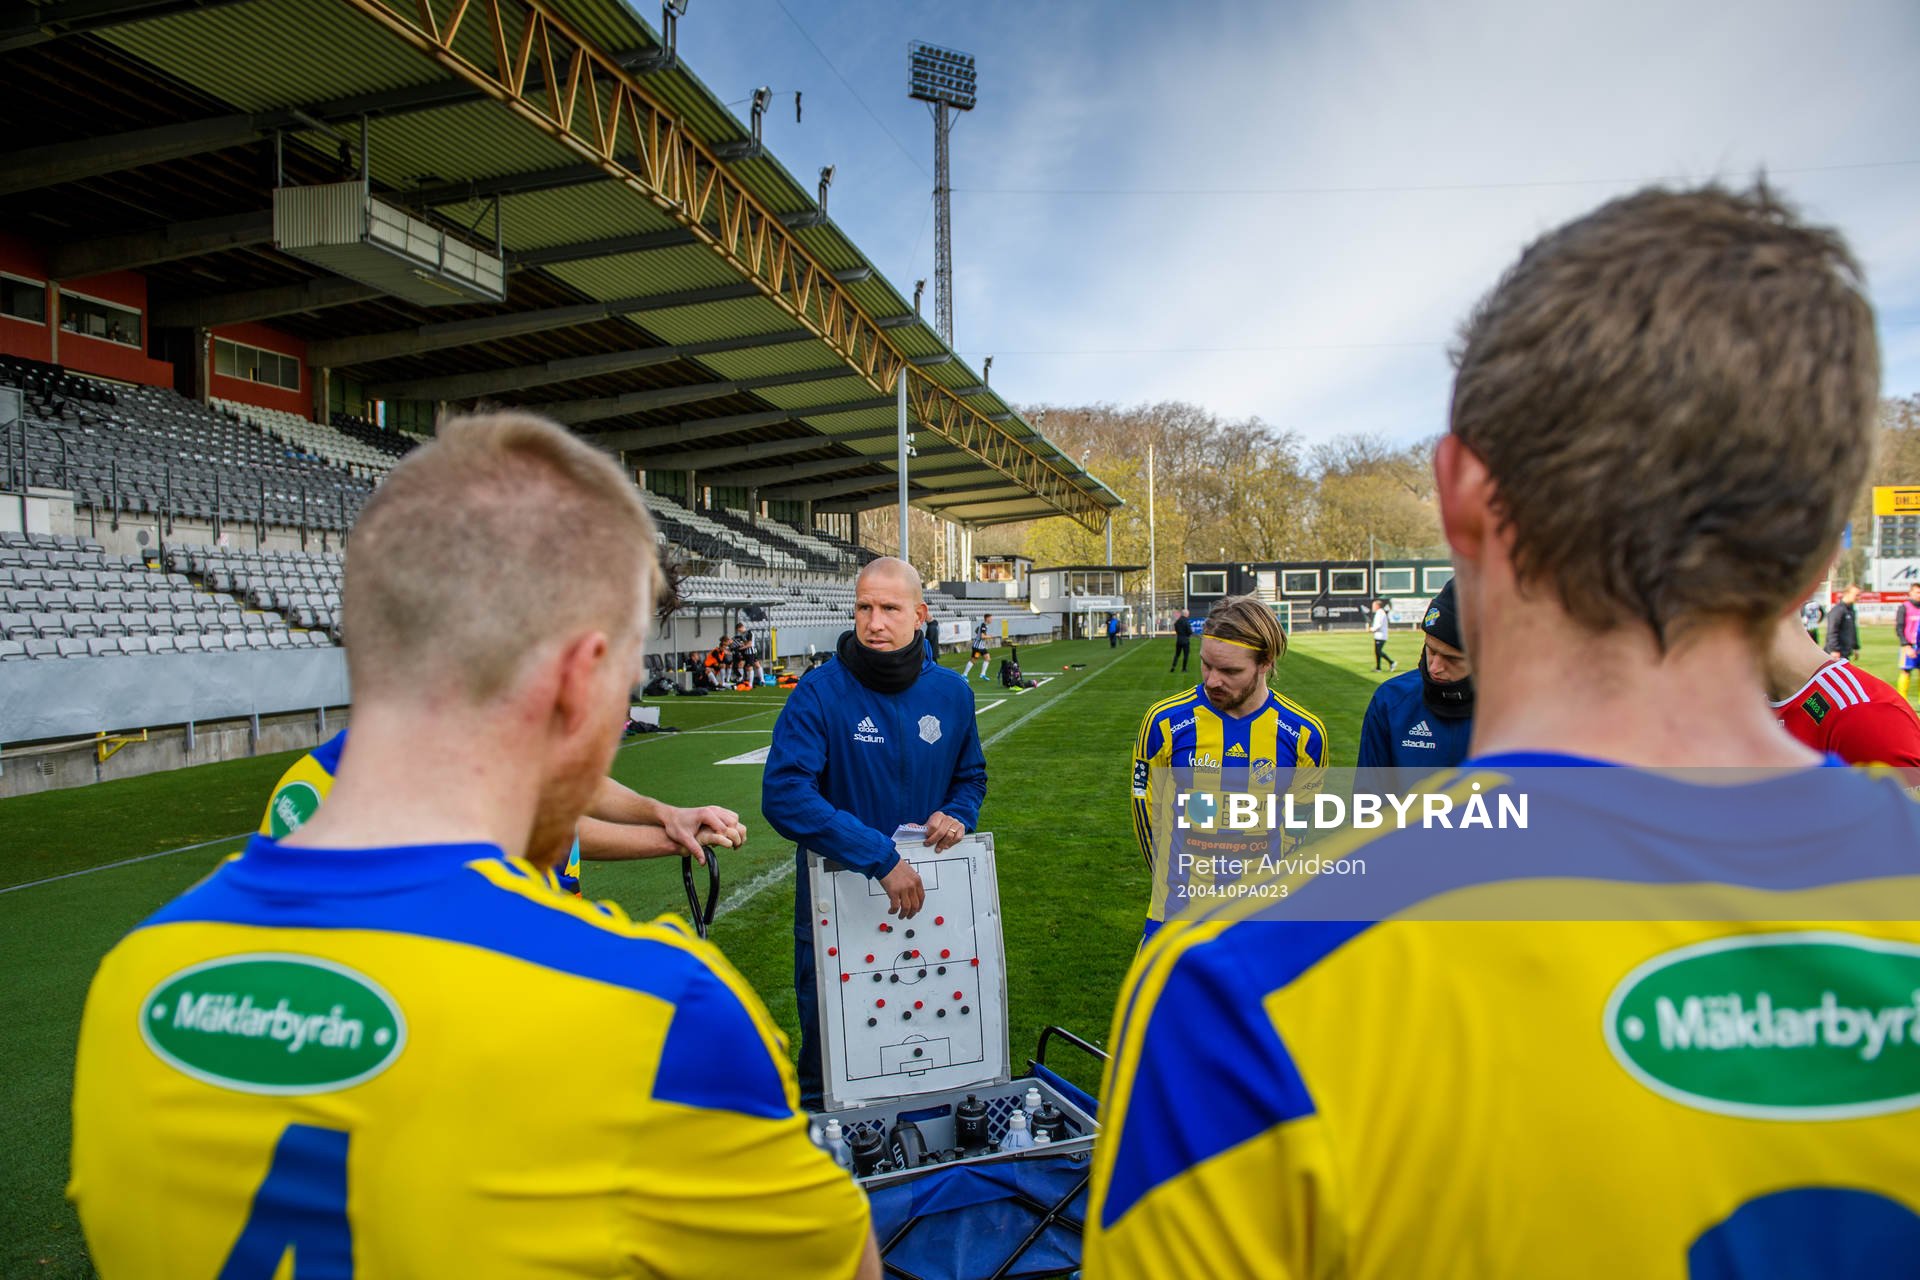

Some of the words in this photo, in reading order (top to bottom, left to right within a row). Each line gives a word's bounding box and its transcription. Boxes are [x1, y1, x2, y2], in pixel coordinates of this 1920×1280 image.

[853, 733, 885, 744] stadium
[1408, 729, 1433, 737] adidas
[1401, 740, 1436, 749] stadium
[1186, 838, 1247, 853] cargorange
[173, 991, 364, 1053] Mäklarbyrån
